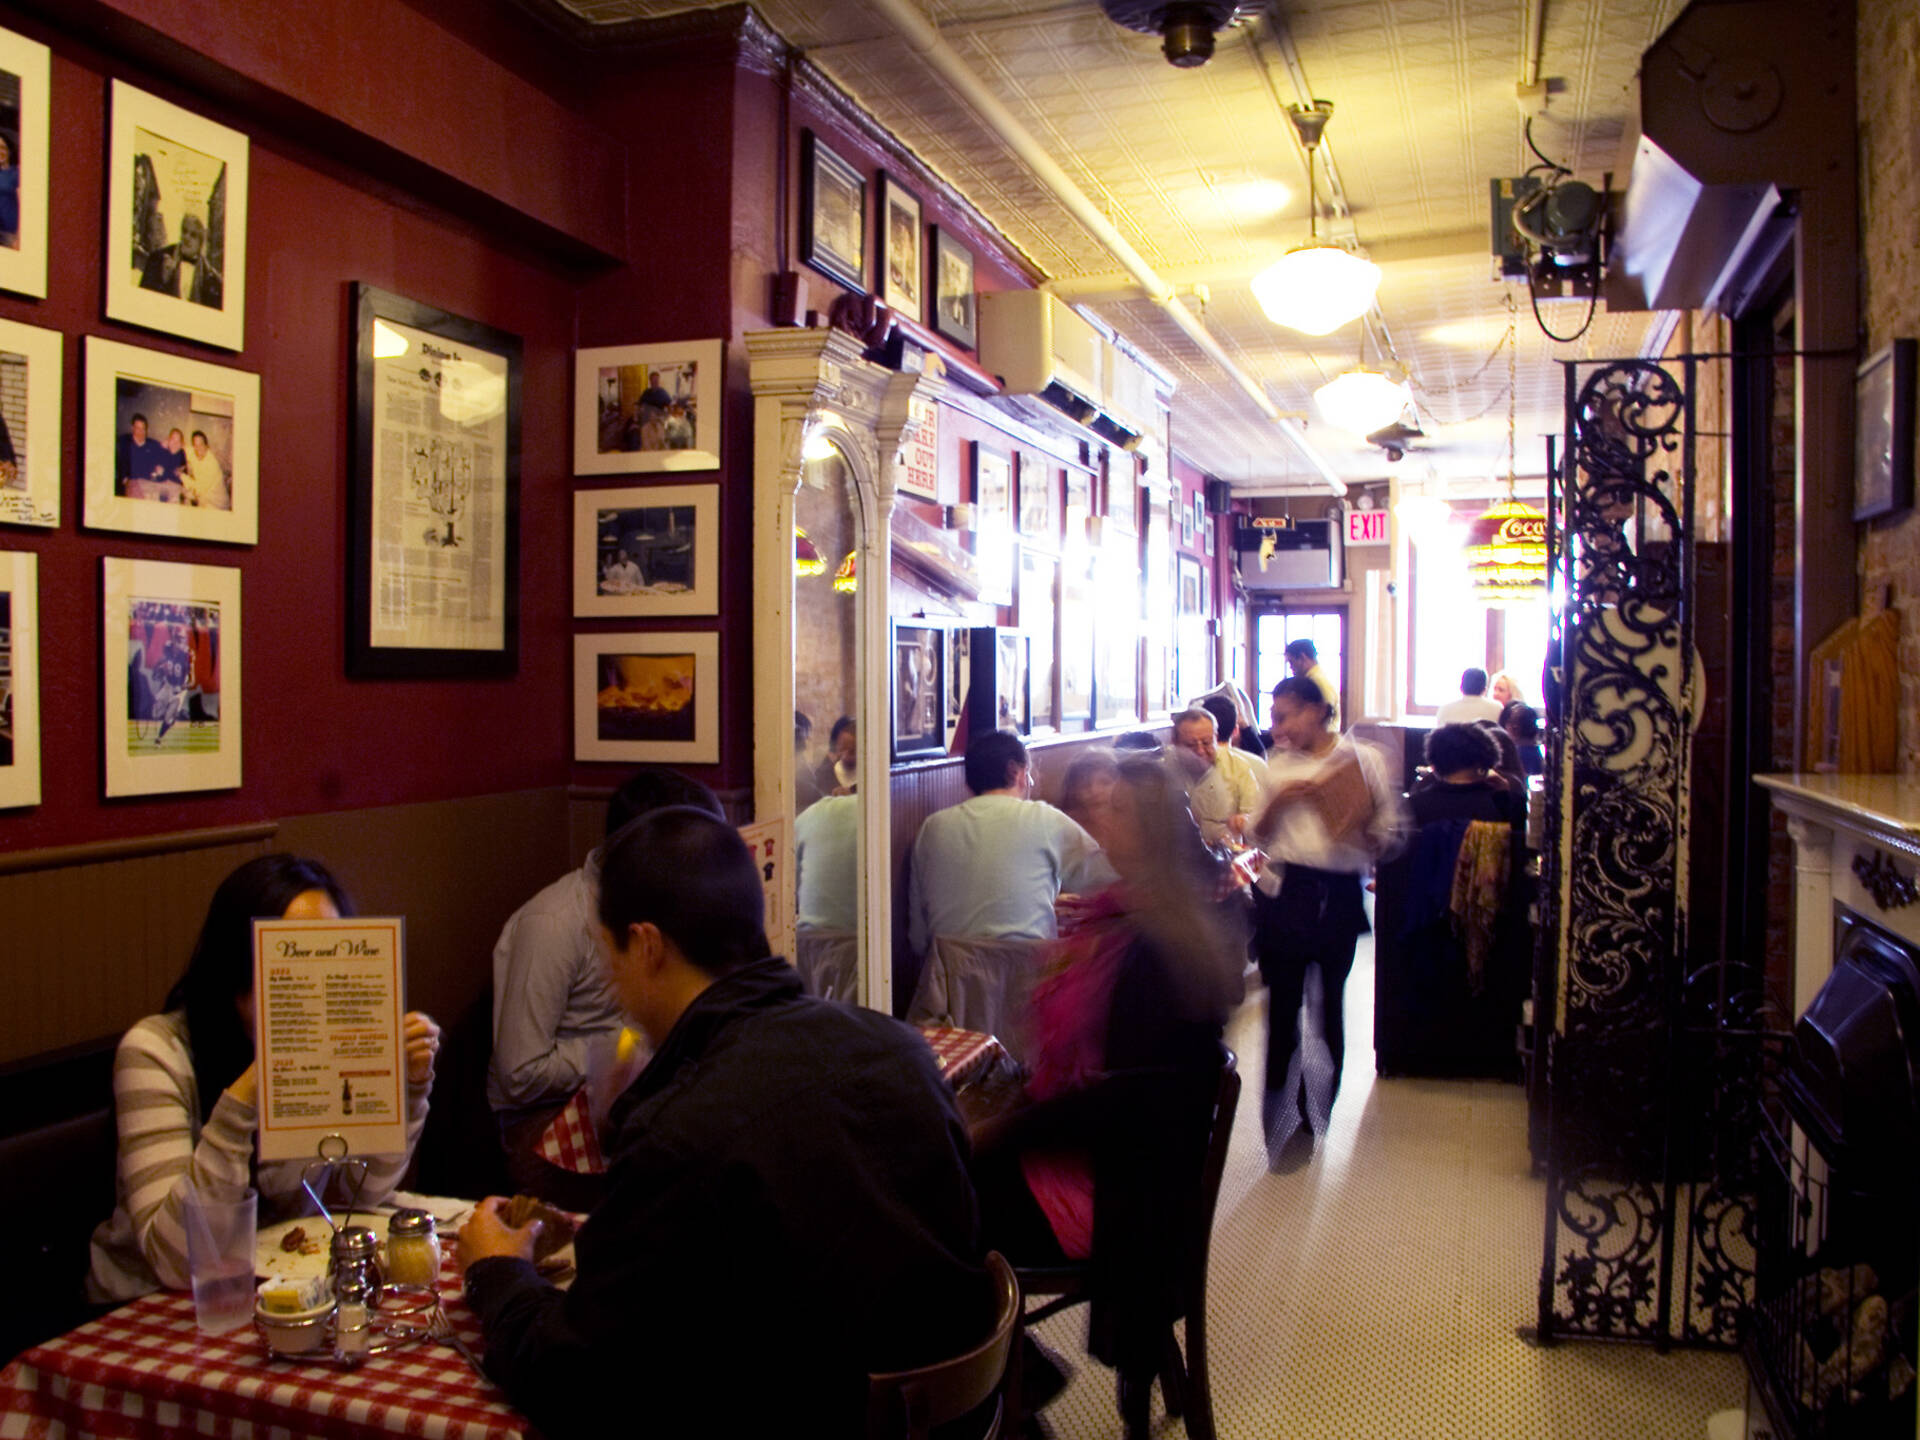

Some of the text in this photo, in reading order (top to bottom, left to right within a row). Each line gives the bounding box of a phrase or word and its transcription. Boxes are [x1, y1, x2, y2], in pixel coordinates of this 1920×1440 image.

[915, 447, 935, 470] OUT
[907, 466, 935, 491] HERE
[1350, 512, 1386, 541] EXIT
[276, 939, 380, 958] Beer and Wine
